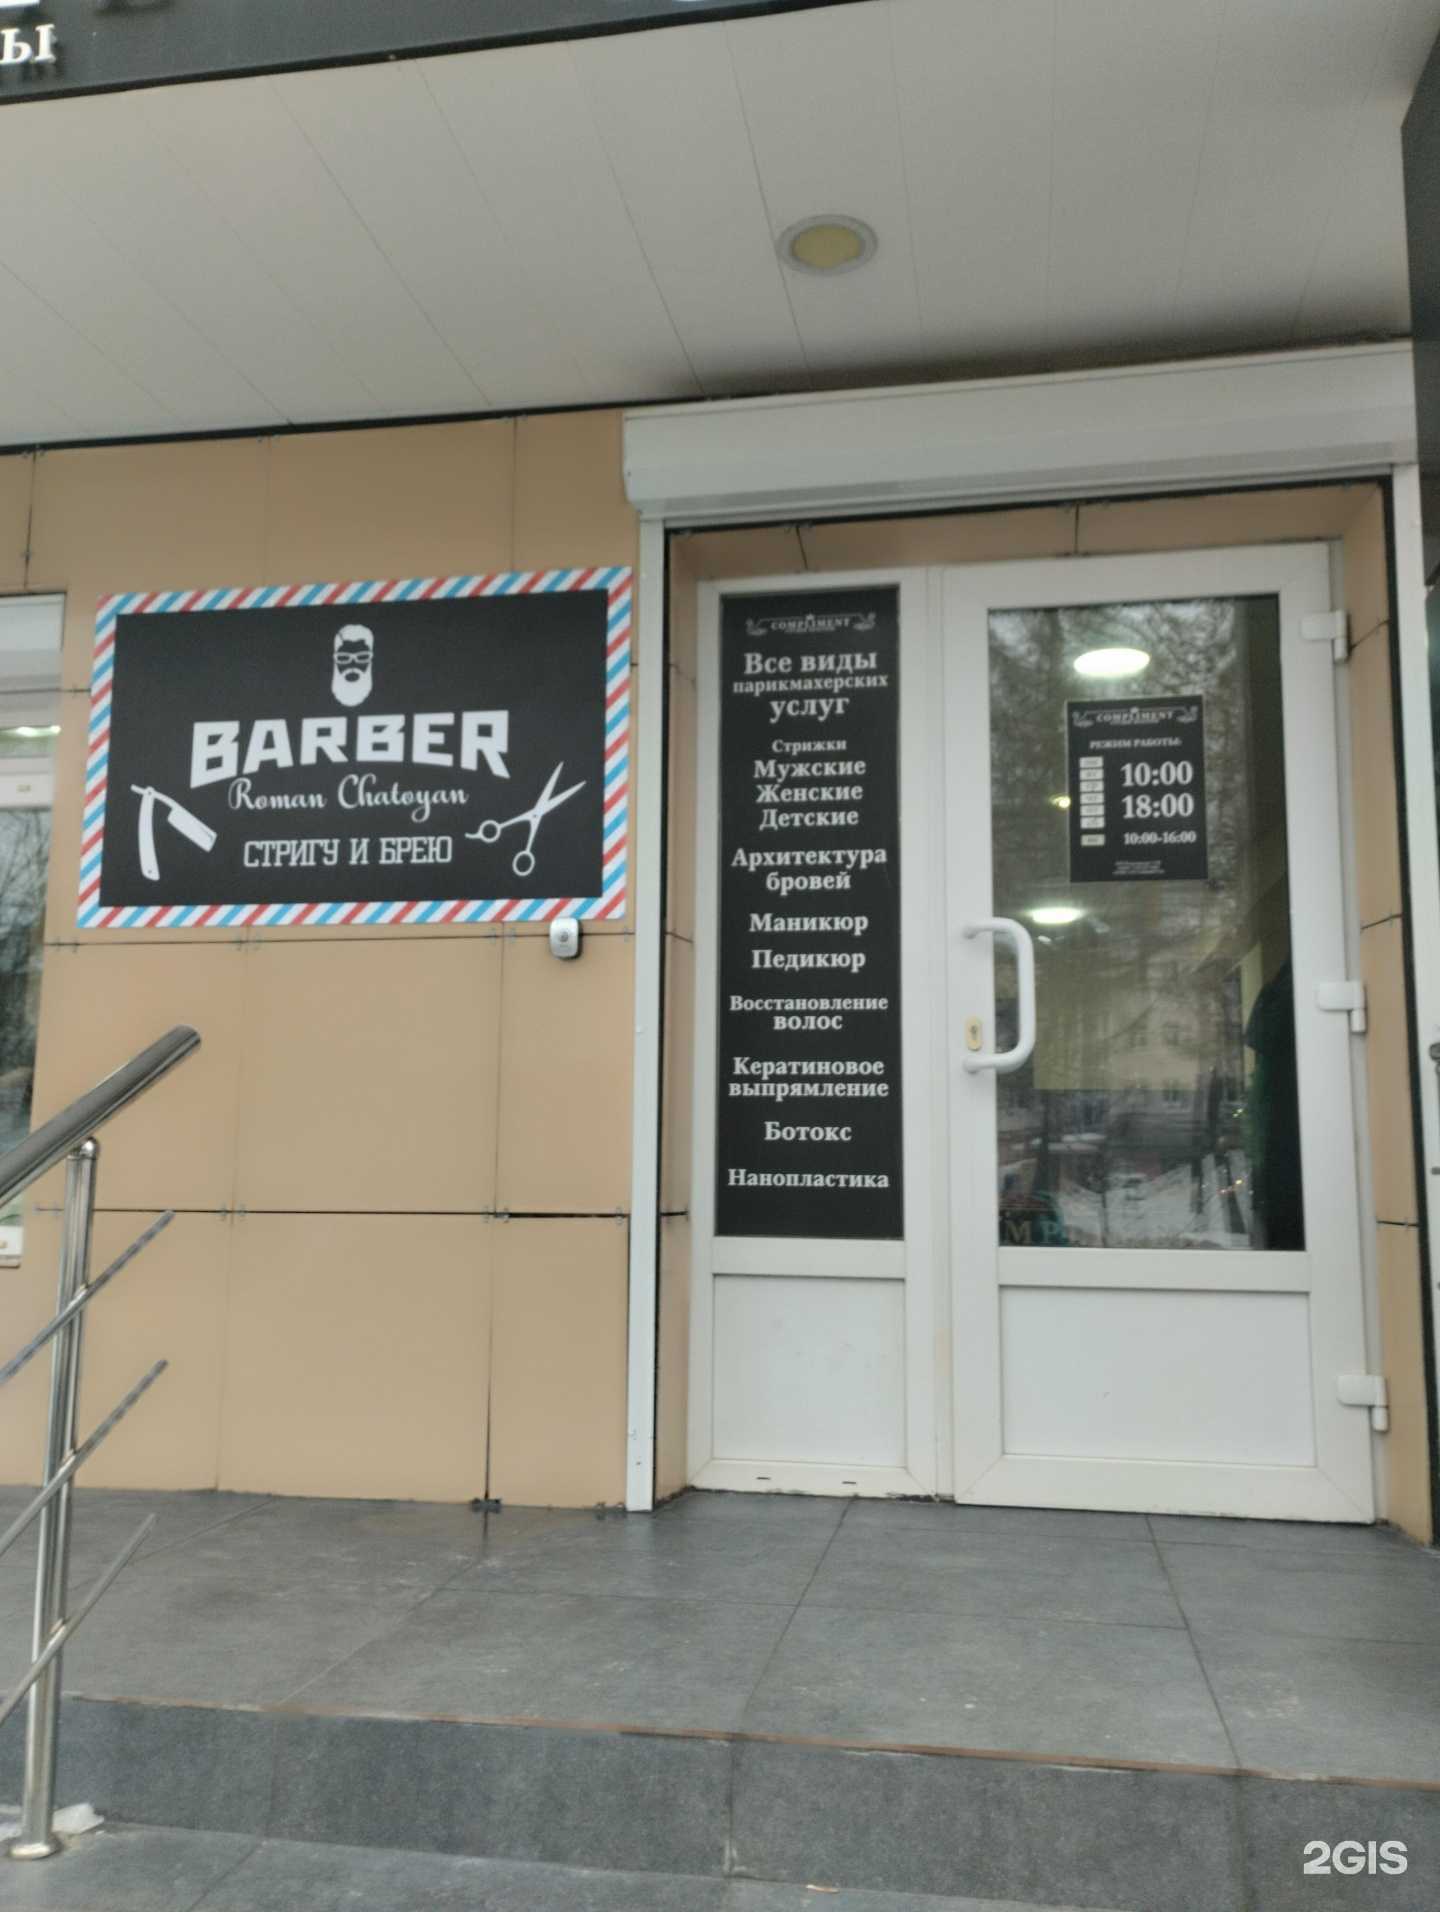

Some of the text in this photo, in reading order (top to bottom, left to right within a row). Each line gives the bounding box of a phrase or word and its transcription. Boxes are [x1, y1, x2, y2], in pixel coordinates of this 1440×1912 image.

[744, 651, 877, 674] Все виды
[732, 673, 889, 696] парикмахерских
[769, 697, 851, 724] услуг
[190, 710, 511, 789] BARBER
[772, 740, 846, 755] Стрижки
[753, 760, 867, 783] Мужские
[1122, 761, 1193, 786] 10:00
[227, 773, 469, 823] Roman Chatoyan
[756, 782, 863, 803] Женские
[1122, 793, 1194, 818] 18:00
[760, 809, 858, 830] Детские
[1124, 831, 1196, 844] 10:00-16:00
[244, 836, 452, 867] СТРИГУ И БРЕЮ
[732, 848, 887, 874] Архитектура
[766, 872, 850, 896] бровей
[750, 913, 868, 936] Маникюр
[752, 950, 865, 973] Педикюр
[729, 995, 889, 1012] Восстановление
[773, 1014, 843, 1031] волос
[734, 1057, 884, 1080] Кератиновое
[729, 1083, 888, 1102] выпрямление
[765, 1122, 851, 1141] Ботокс
[728, 1169, 889, 1188] Нанопластика
